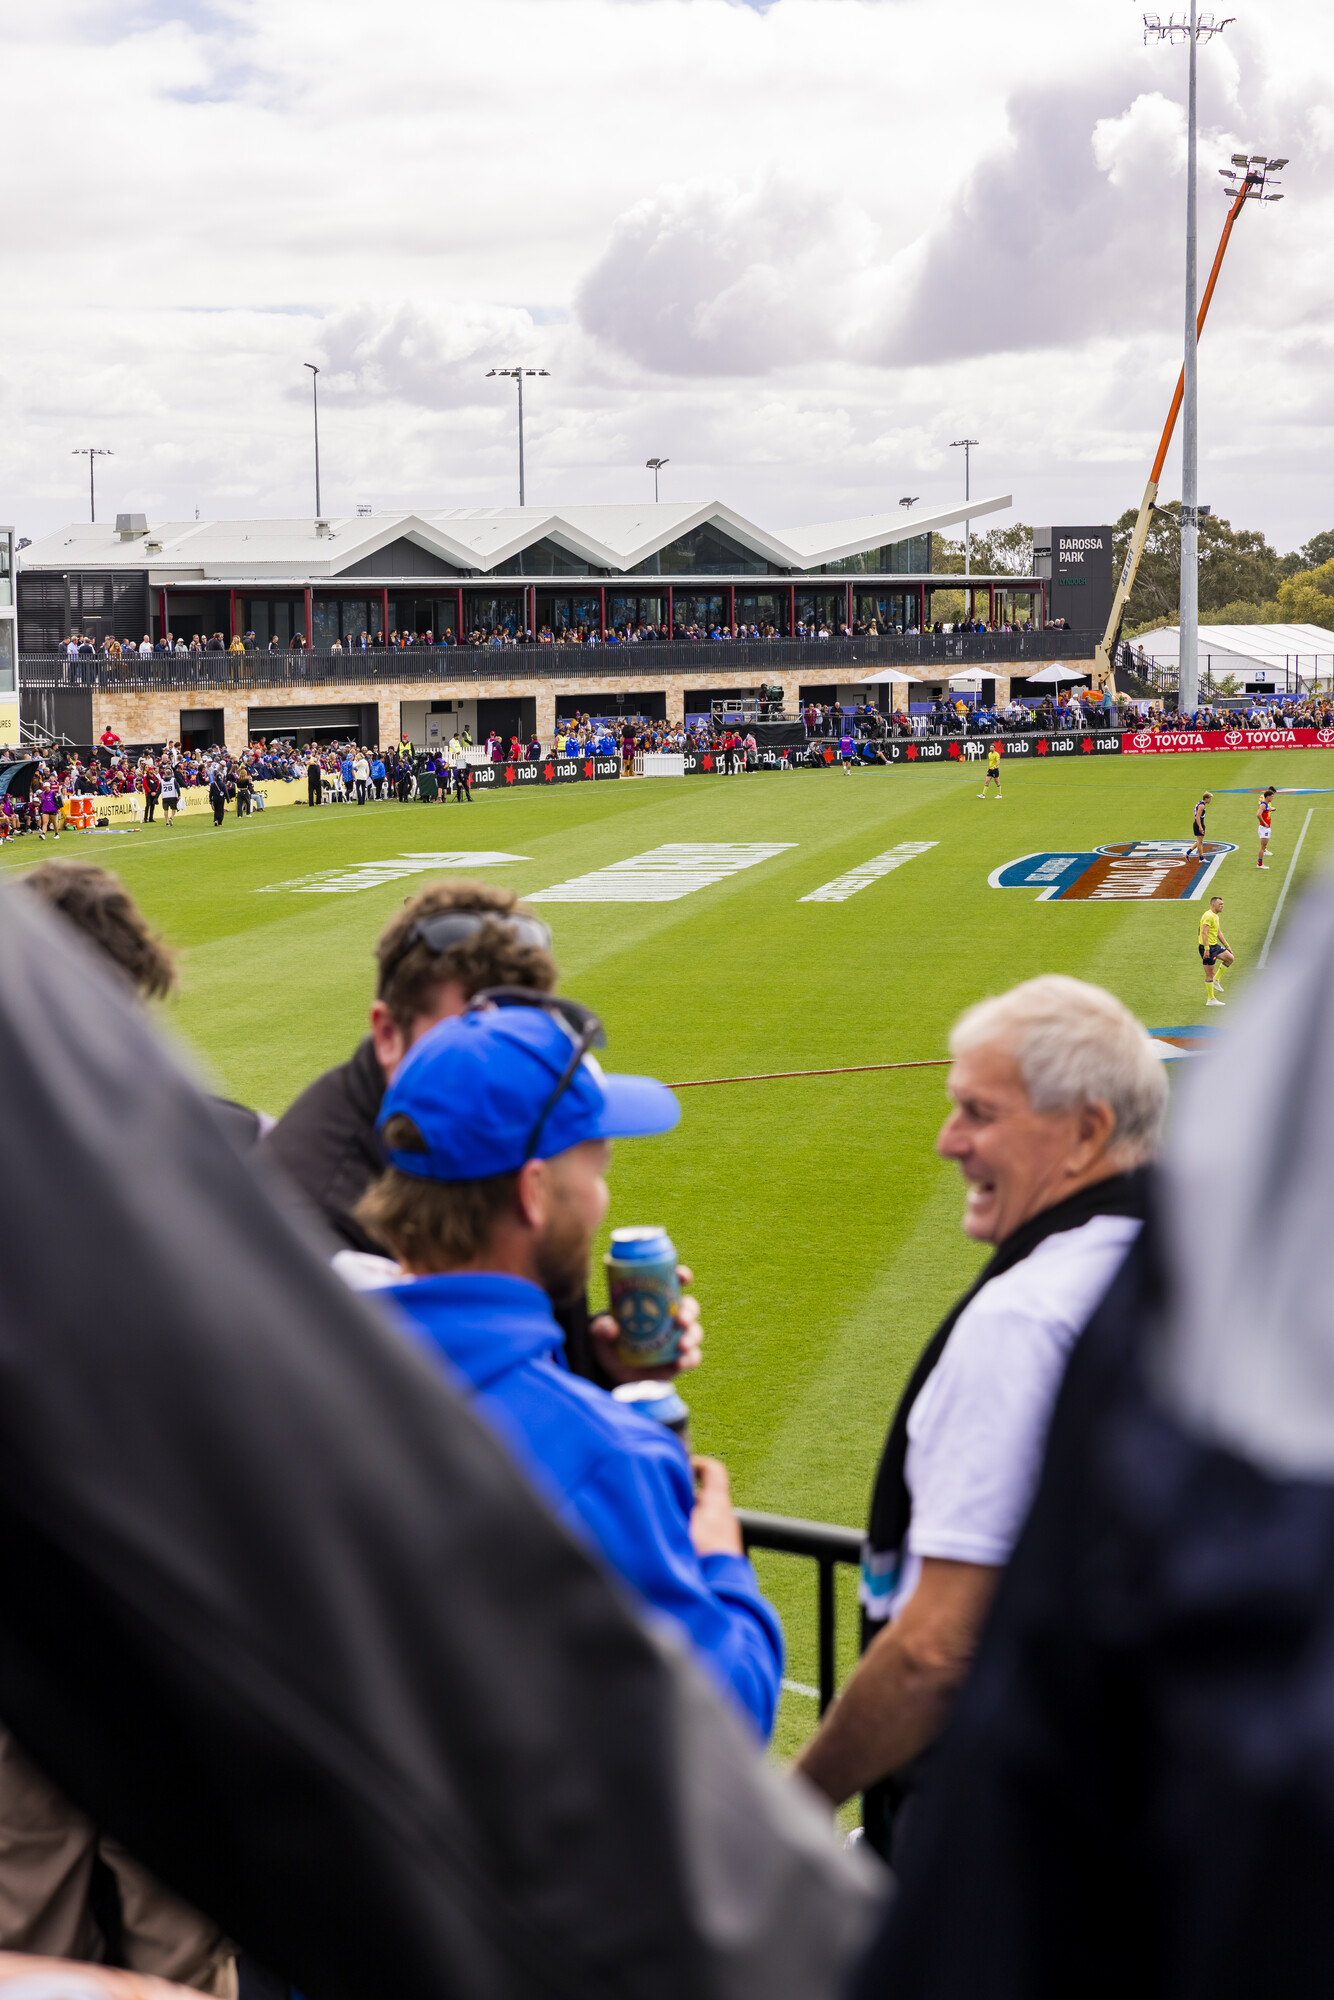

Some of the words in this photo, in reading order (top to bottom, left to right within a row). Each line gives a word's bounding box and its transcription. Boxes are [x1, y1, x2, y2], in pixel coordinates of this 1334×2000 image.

[1059, 538, 1103, 550] BAROSSA
[1059, 551, 1084, 562] PARK
[1120, 569, 1129, 587] JLG
[1126, 548, 1135, 569] LIFT
[1059, 577, 1087, 585] LYNDOCH
[1096, 736, 1119, 750] nab
[1154, 733, 1204, 746] TOYOTA
[1245, 730, 1296, 743] TOYOTA
[920, 743, 942, 757] nab
[1006, 739, 1029, 753] nab
[1051, 738, 1074, 751] nab
[597, 760, 617, 774] nab
[683, 752, 697, 769] ab
[475, 767, 495, 783] nab
[517, 764, 538, 780] nab
[557, 762, 577, 777] nab
[99, 803, 132, 817] AUSTRALIA
[598, 842, 801, 871] GATHER
[288, 868, 425, 893] SOUTH
[515, 870, 739, 902] ROUND
[1088, 869, 1171, 899] TOYOTA
